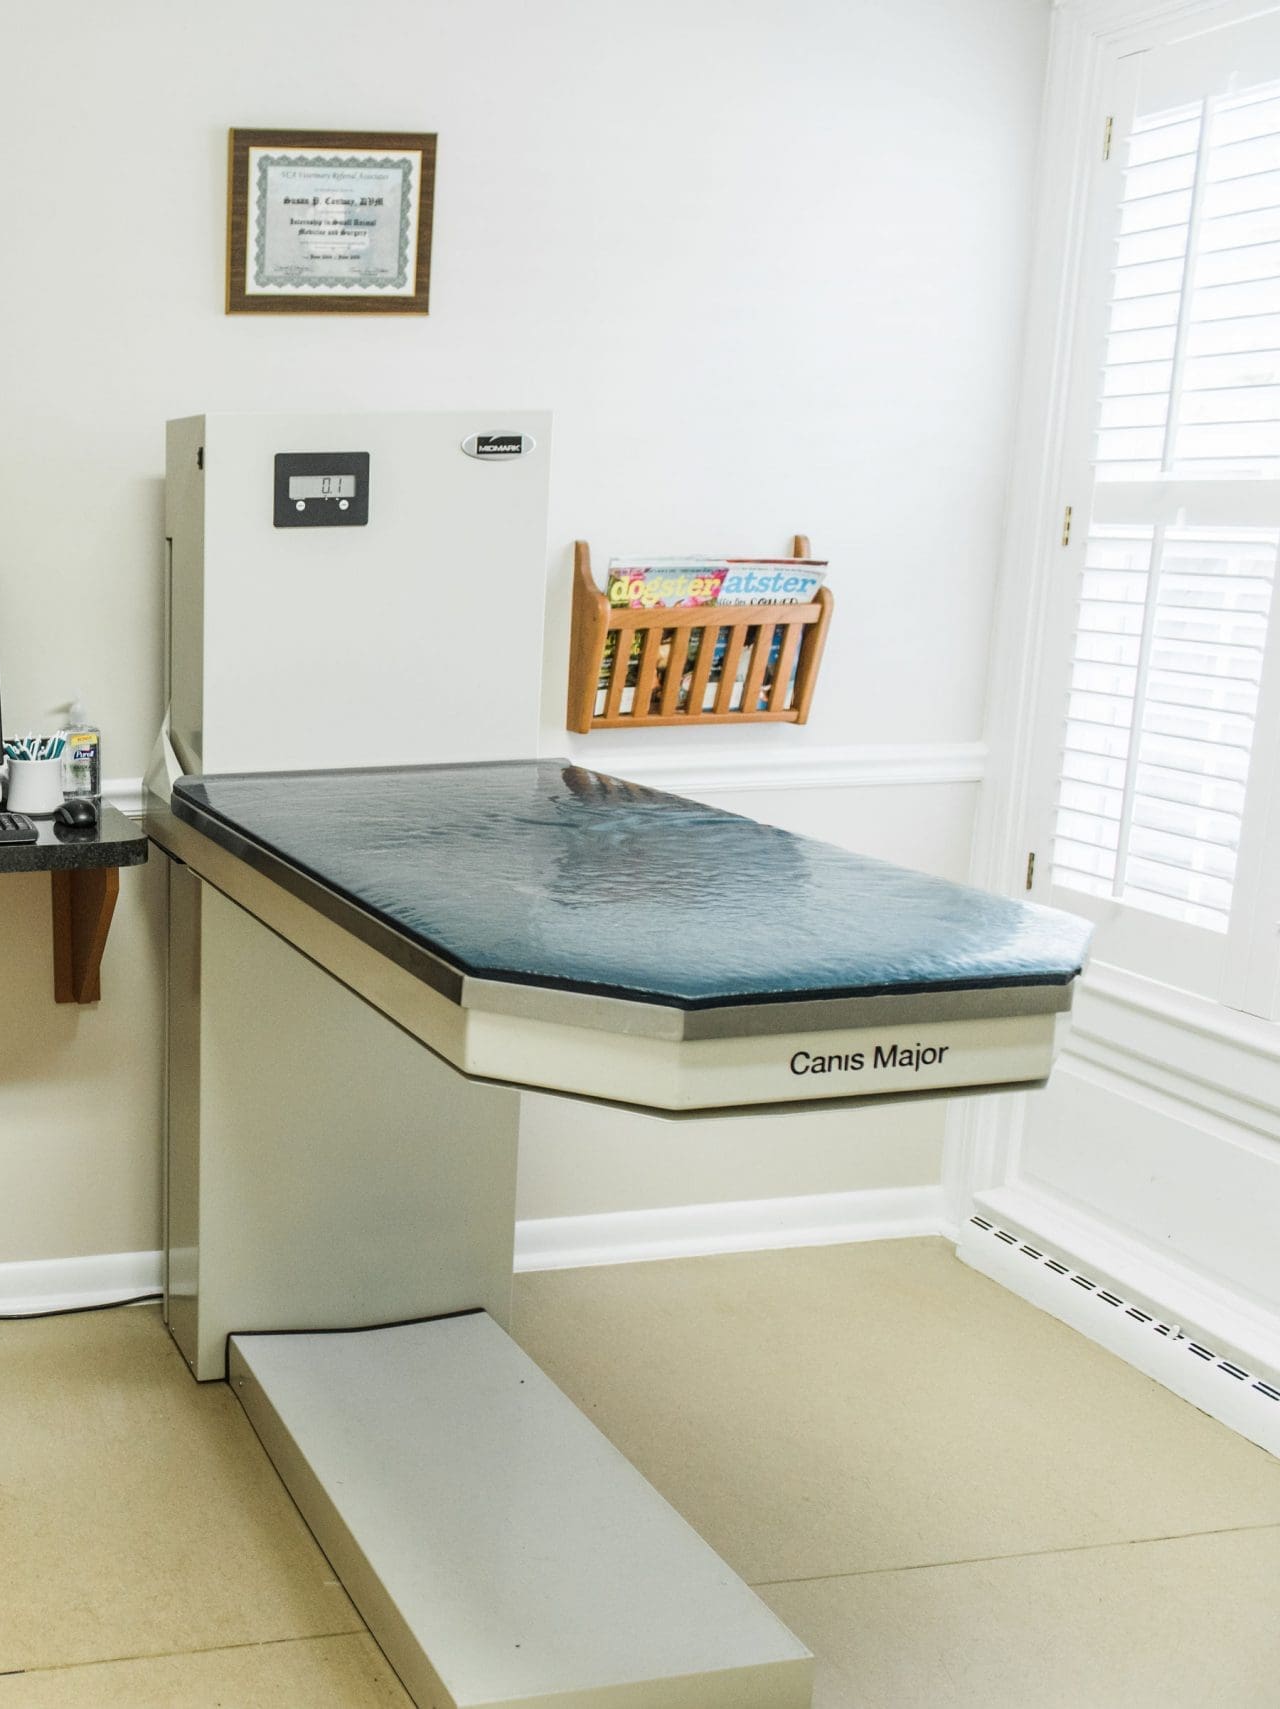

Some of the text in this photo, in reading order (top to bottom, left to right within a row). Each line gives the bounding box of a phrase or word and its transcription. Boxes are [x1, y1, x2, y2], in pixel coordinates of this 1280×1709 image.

[479, 444, 521, 453] MIDMARK
[610, 575, 721, 605] dogster
[724, 571, 817, 594] atster
[790, 1042, 949, 1075] Canis Major
